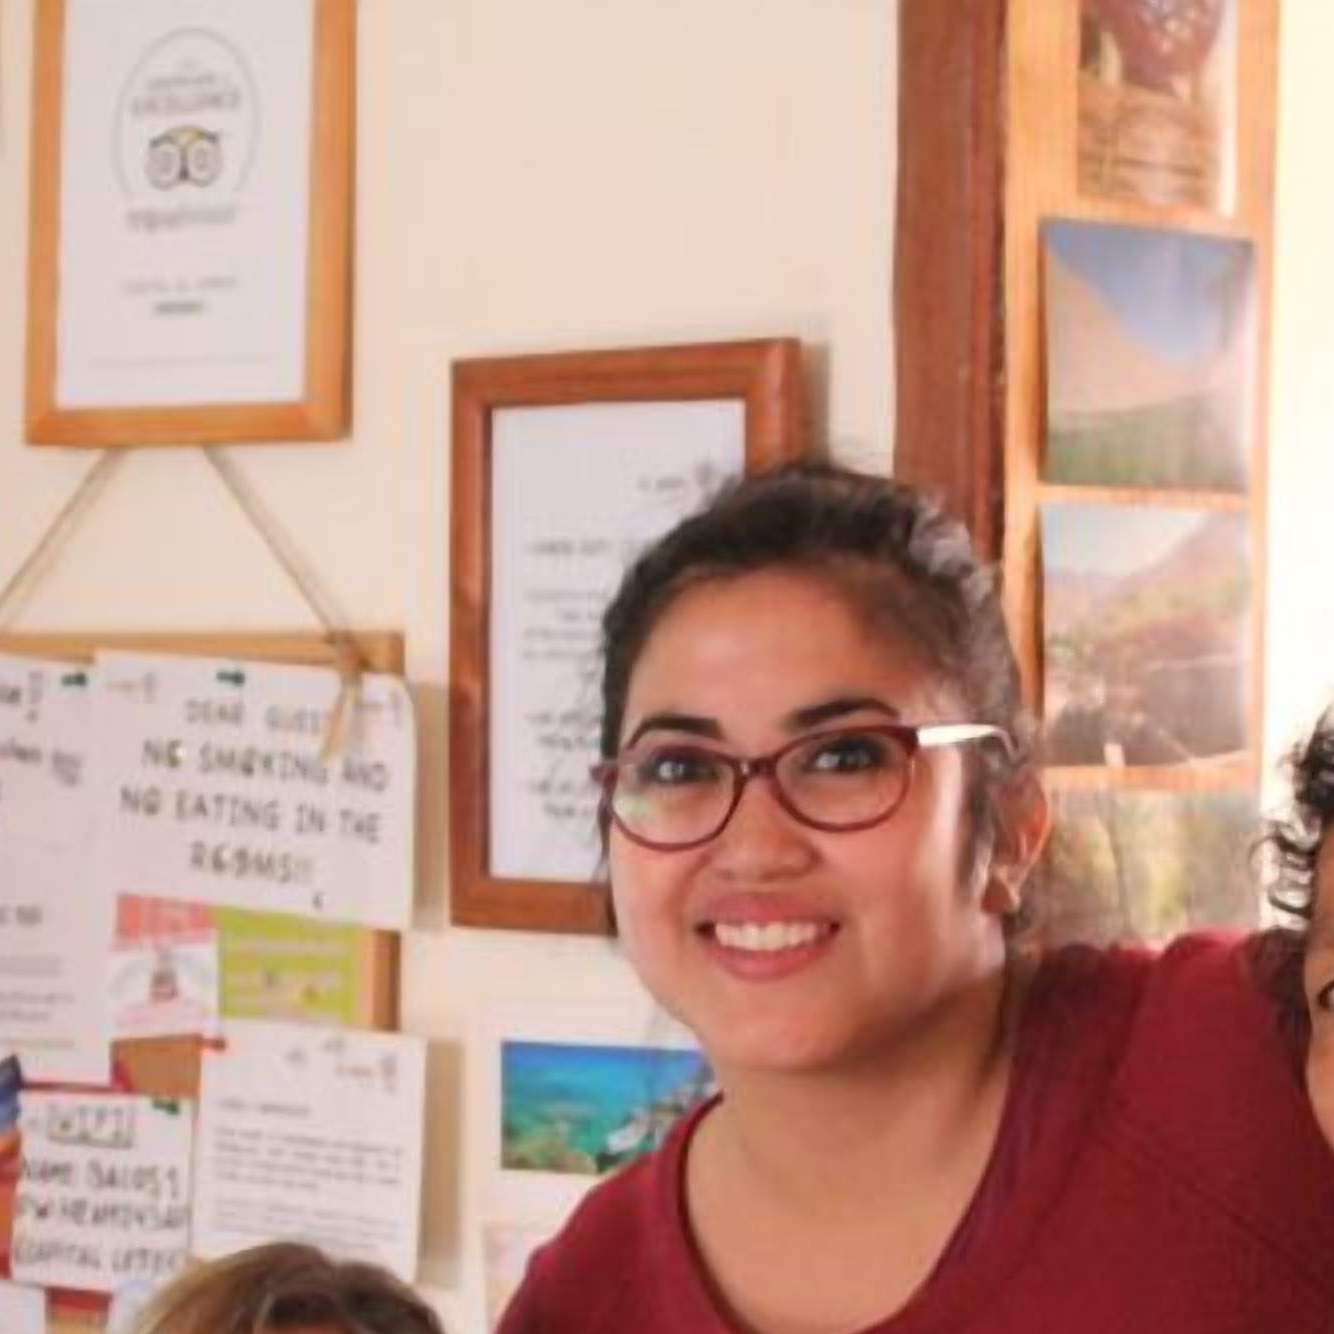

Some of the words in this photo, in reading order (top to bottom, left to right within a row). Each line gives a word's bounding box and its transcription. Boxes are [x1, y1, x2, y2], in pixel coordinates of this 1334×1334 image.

[176, 788, 280, 832] EATING
[295, 803, 326, 834] IN
[338, 807, 381, 845] THE
